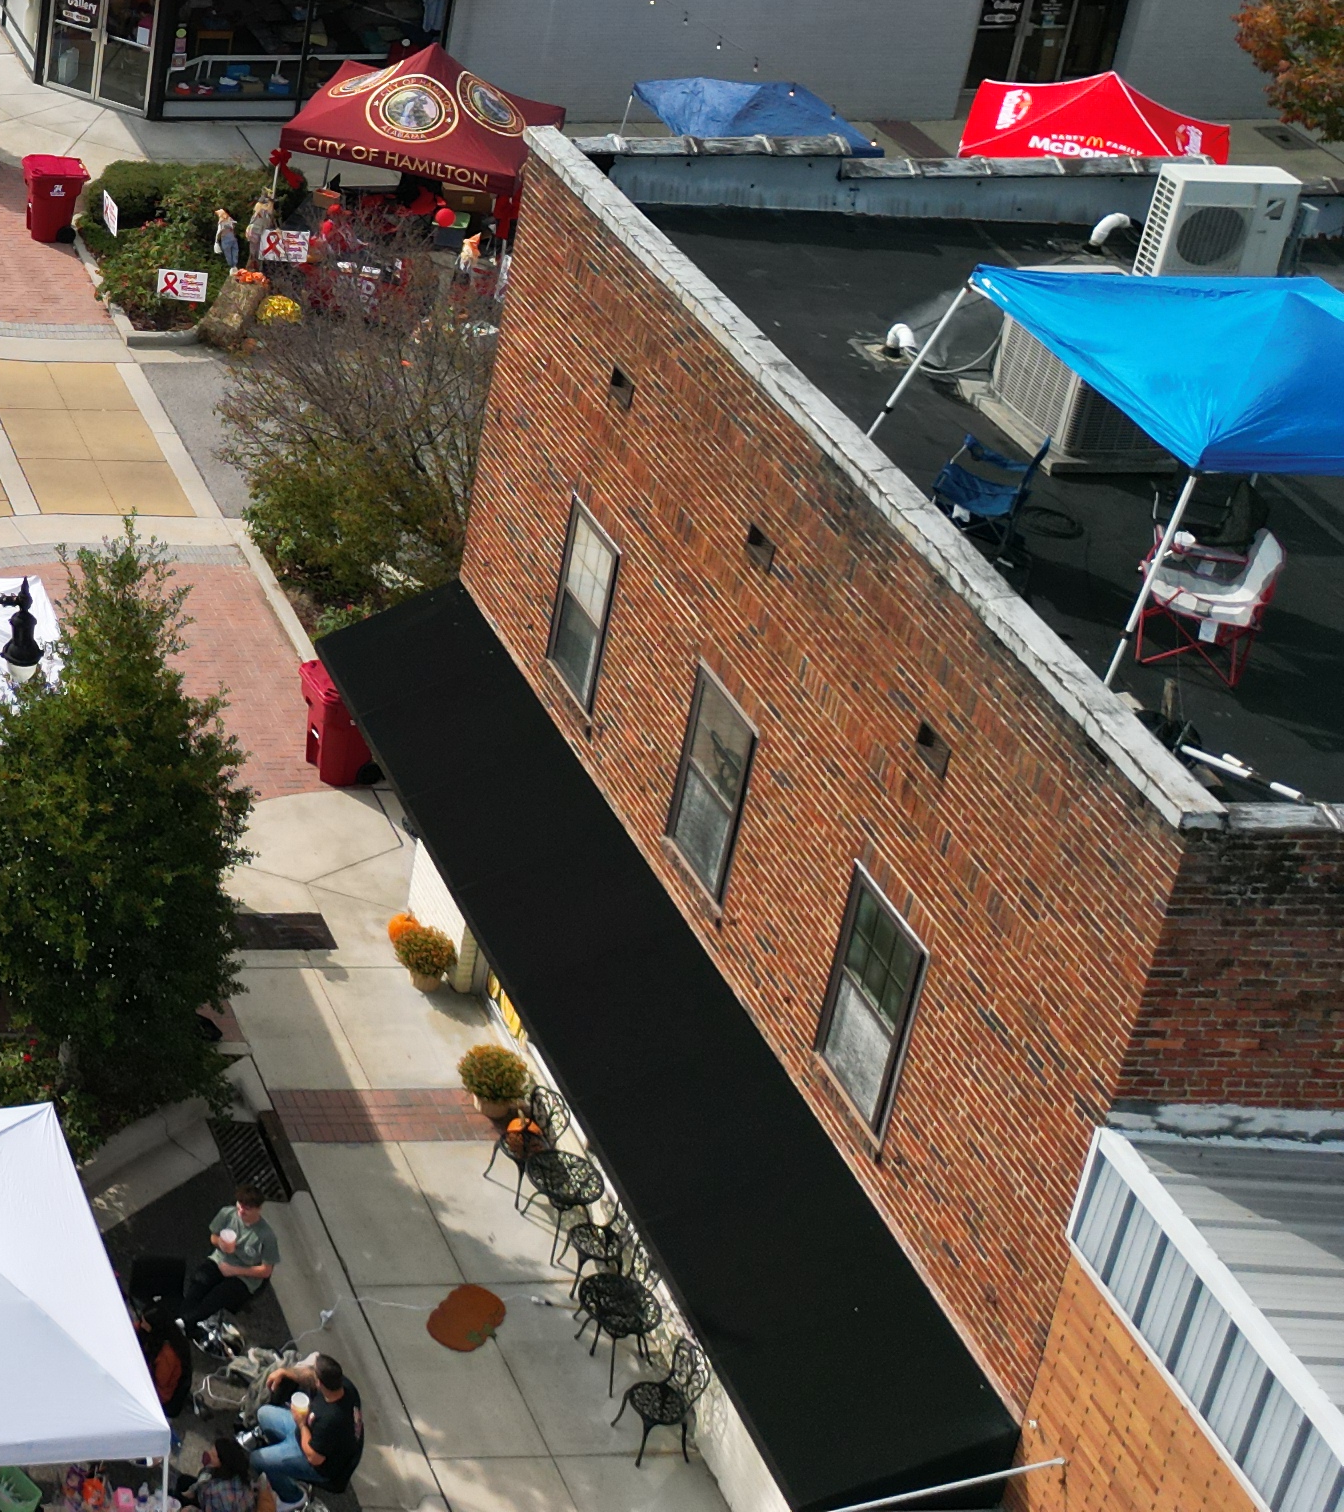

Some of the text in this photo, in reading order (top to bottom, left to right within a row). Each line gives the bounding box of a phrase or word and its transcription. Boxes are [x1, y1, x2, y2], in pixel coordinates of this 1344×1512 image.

[380, 125, 427, 139] ALABAMA
[1105, 141, 1143, 156] FAMILY
[304, 137, 489, 187] CITY OF HAMILTON
